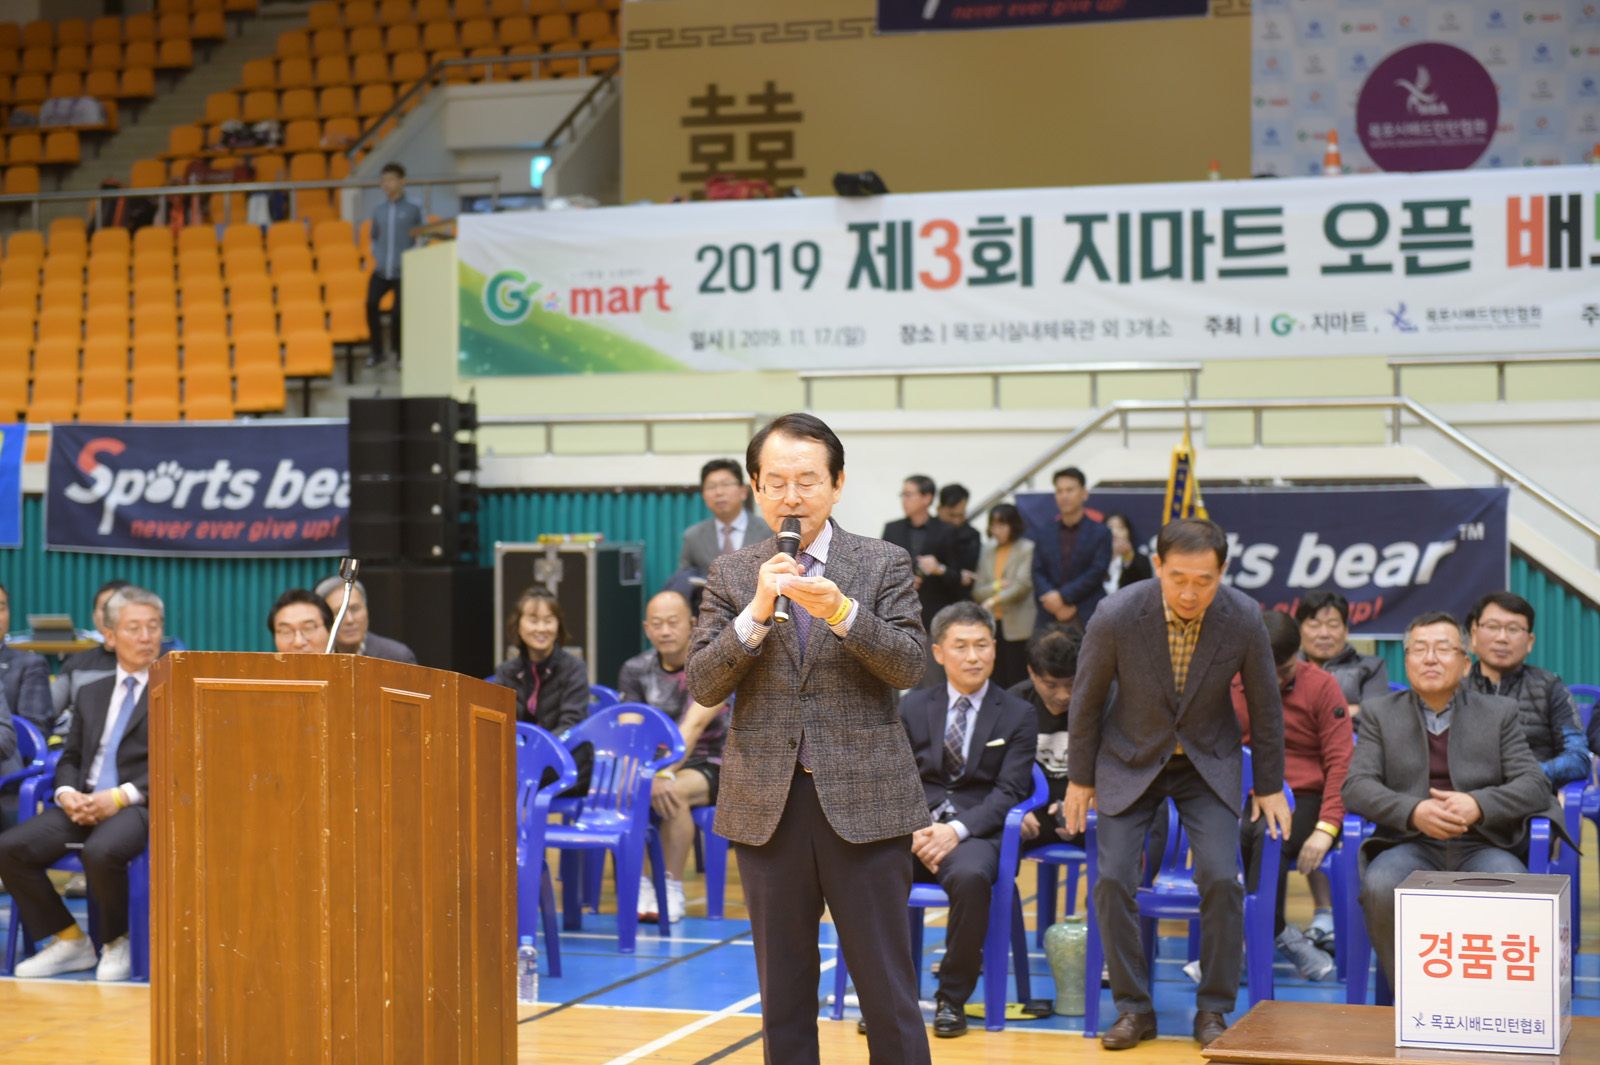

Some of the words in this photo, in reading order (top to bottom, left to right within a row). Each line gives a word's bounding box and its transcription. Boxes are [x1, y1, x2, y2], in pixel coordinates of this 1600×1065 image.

[696, 240, 822, 294] 2019
[846, 214, 1035, 291] 제3회
[1062, 205, 1289, 286] 지마트
[1321, 197, 1474, 276] 오픈
[570, 276, 671, 316] mart
[690, 329, 723, 351] 일시
[900, 323, 935, 346] 장소
[953, 320, 1096, 344] 목포시실내체육관
[1125, 316, 1173, 340] 3개소
[1205, 314, 1241, 337] 주최
[130, 518, 191, 538] never
[195, 517, 245, 539] ever
[248, 516, 297, 542] give
[301, 515, 340, 541] up!
[1287, 532, 1457, 589] bear
[1418, 931, 1540, 982] 경품함
[1430, 1014, 1546, 1035] 목포시배드민턴협회
